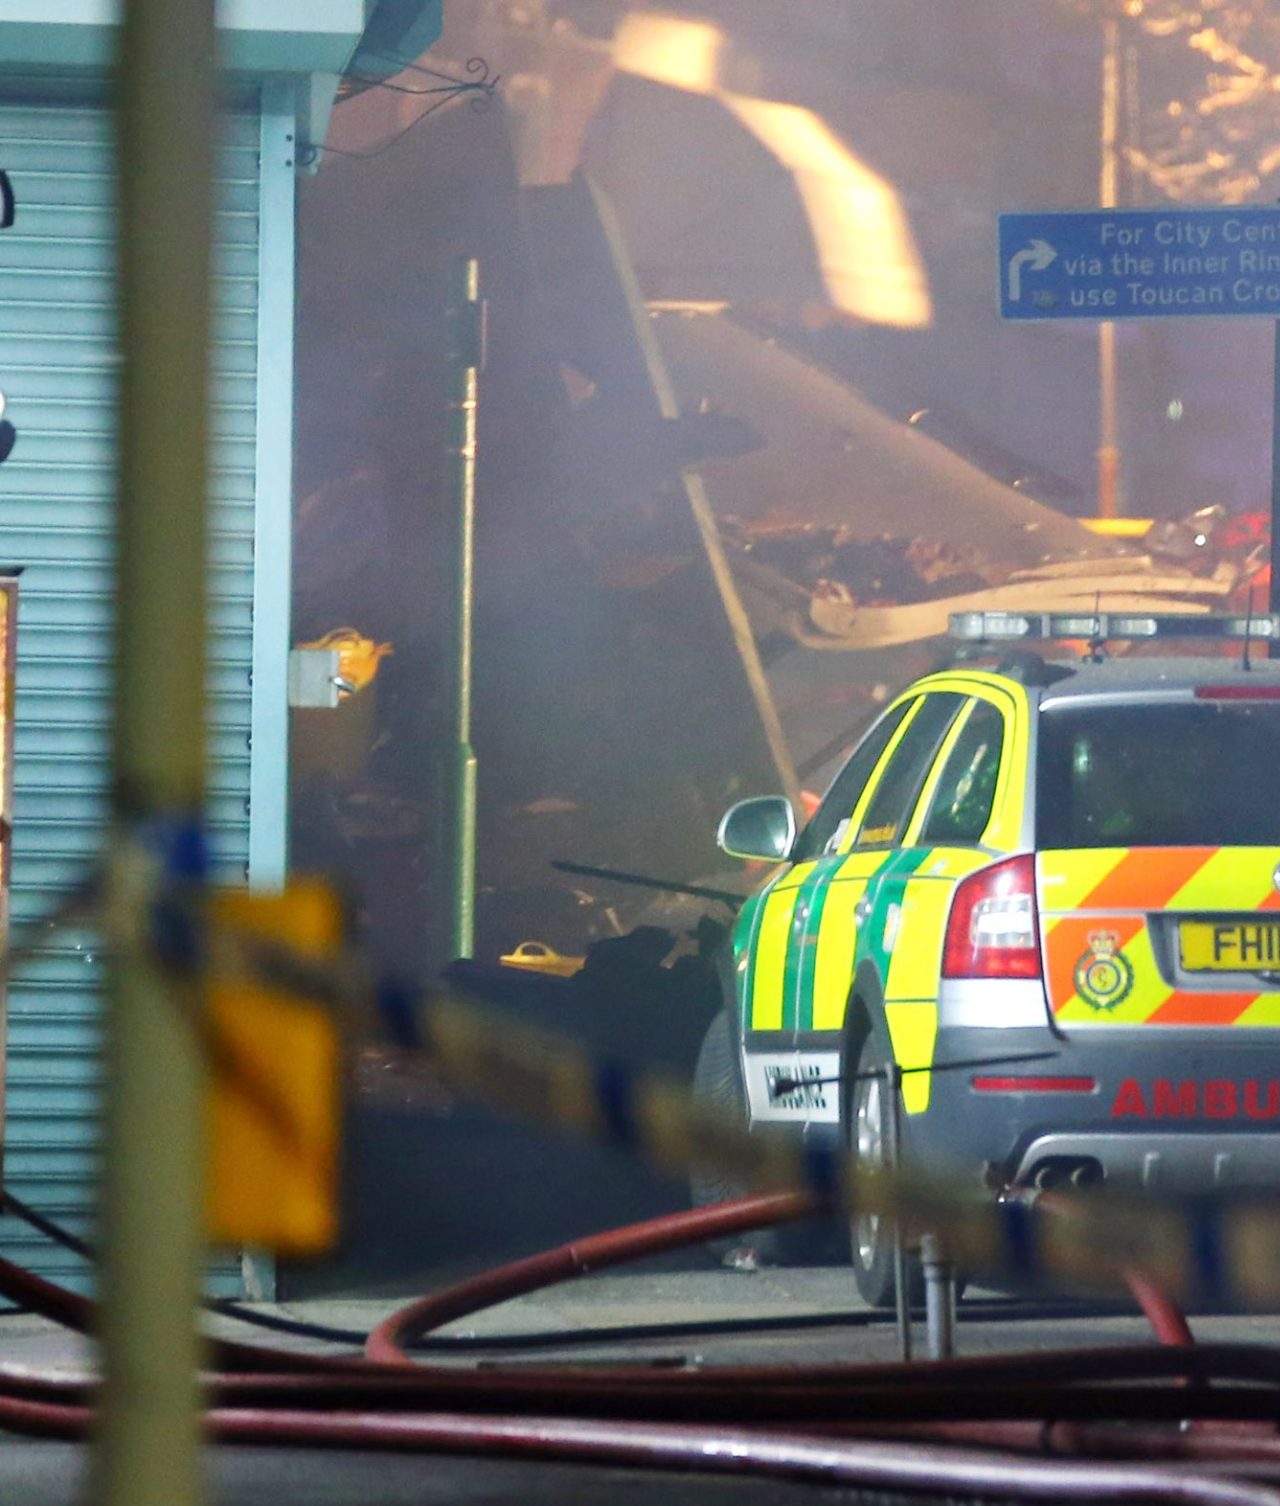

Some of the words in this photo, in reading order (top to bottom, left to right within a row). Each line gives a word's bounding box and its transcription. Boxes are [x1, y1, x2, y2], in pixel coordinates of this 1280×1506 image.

[1101, 223, 1143, 245] For
[1155, 221, 1210, 248] City
[1065, 254, 1101, 276] via
[1112, 252, 1154, 275] the
[1163, 251, 1229, 274] Inner
[1071, 288, 1116, 306] use
[1127, 283, 1223, 305] Toucan
